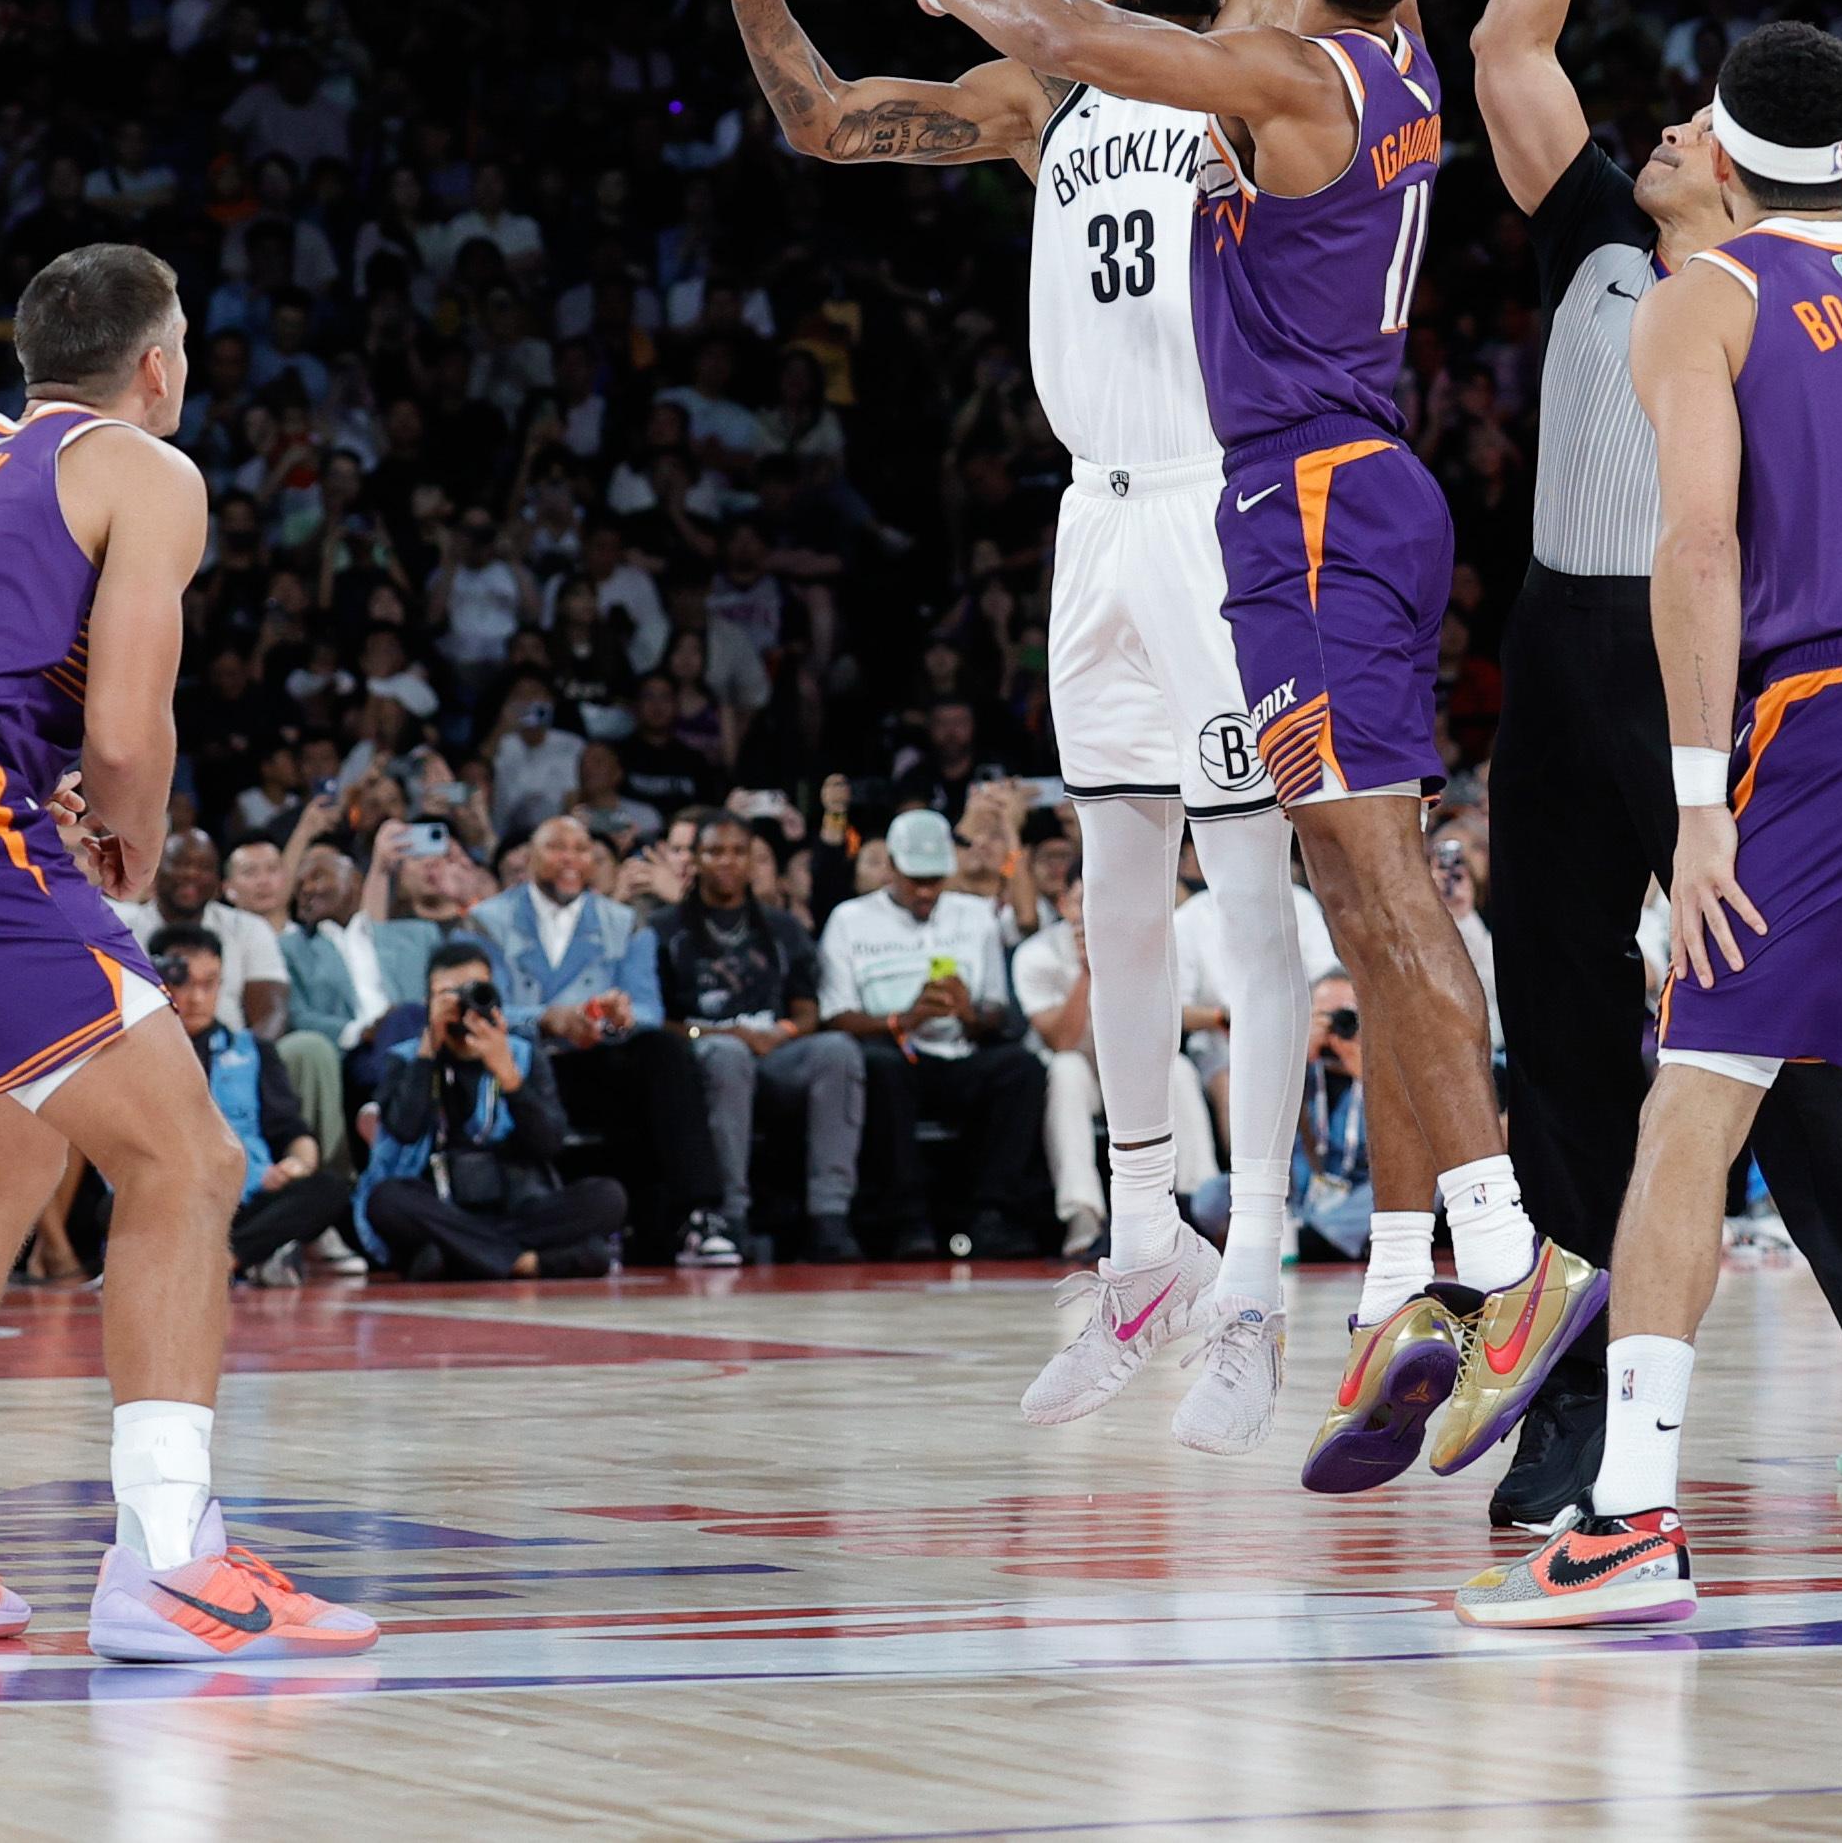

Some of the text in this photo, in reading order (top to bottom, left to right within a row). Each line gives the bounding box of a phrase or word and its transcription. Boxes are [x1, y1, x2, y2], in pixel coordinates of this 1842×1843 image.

[1051, 128, 1204, 208] BROOKLYN
[1087, 209, 1156, 304] 33
[1380, 180, 1429, 334] 11
[1220, 725, 1250, 780] B
